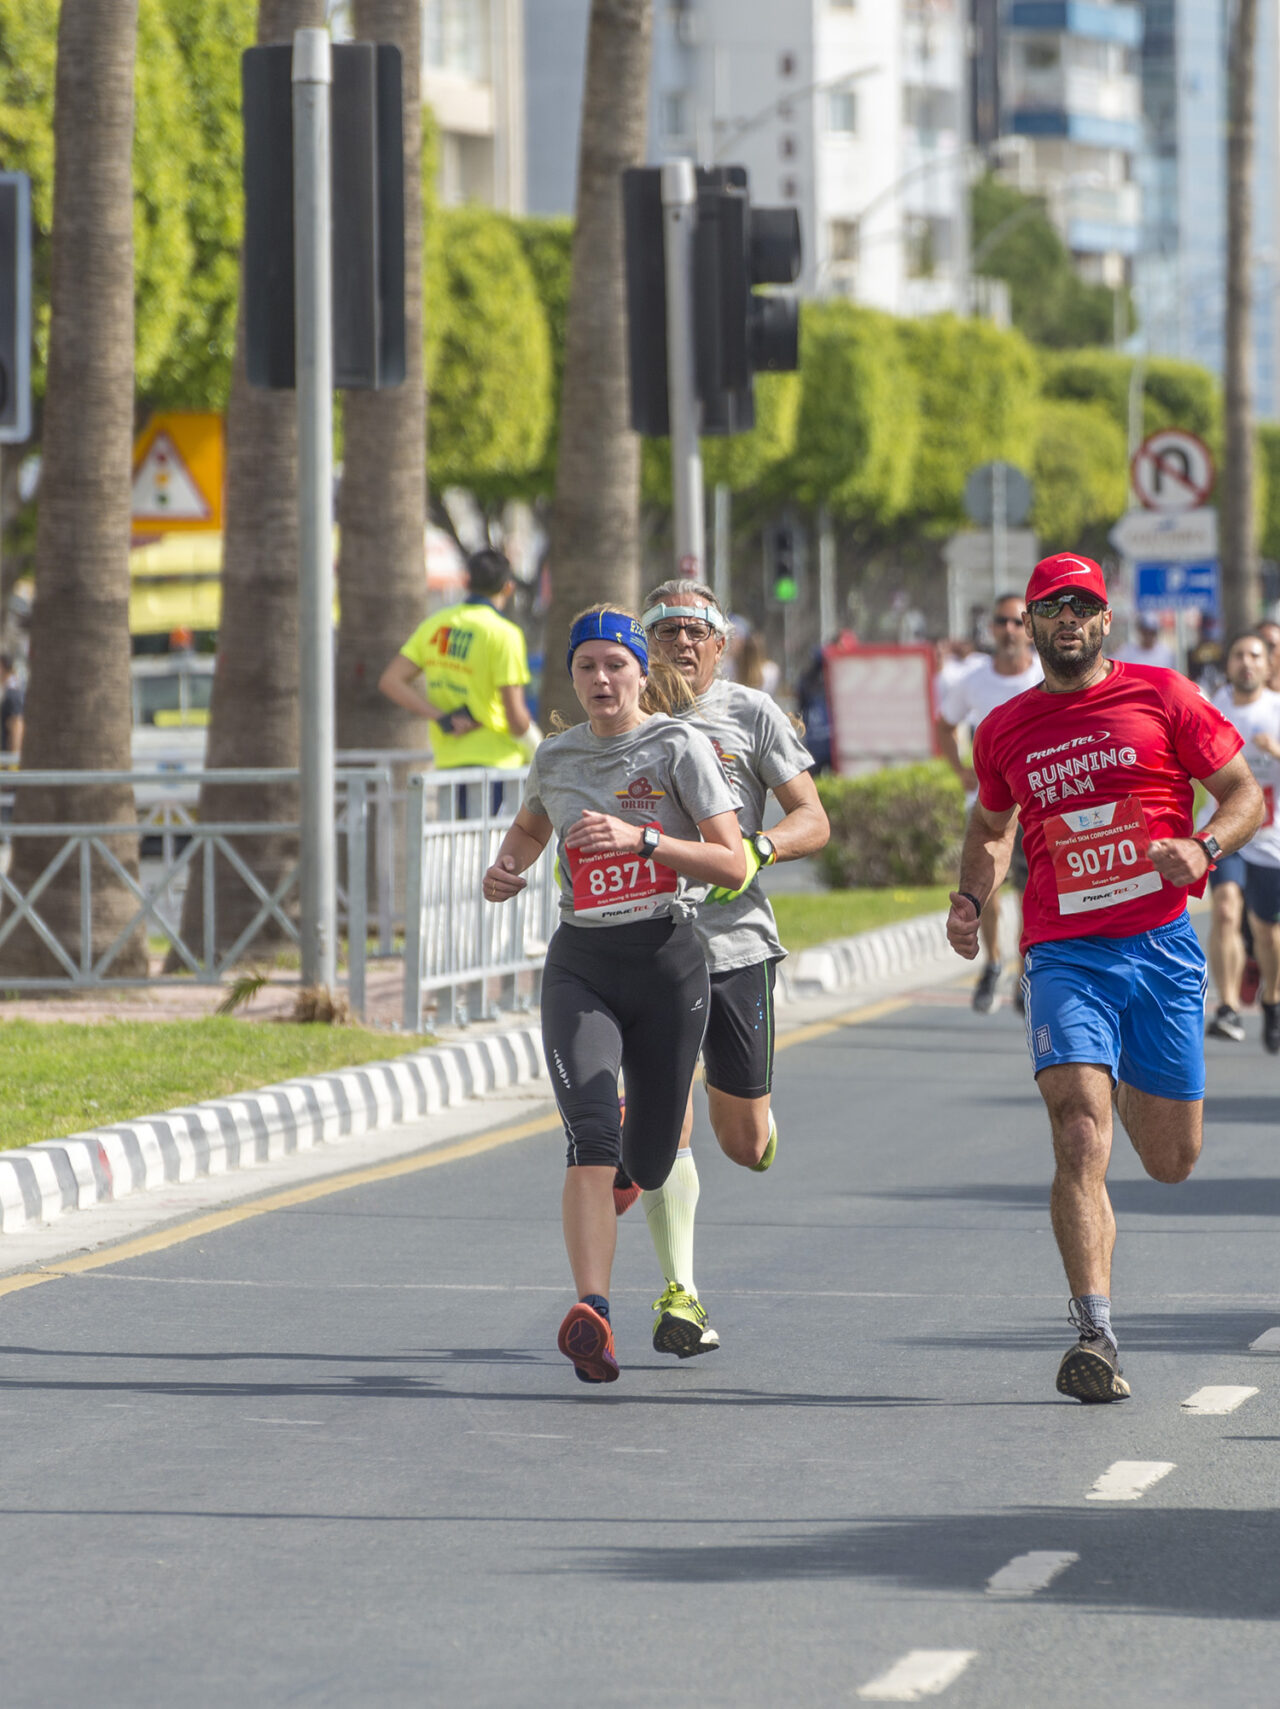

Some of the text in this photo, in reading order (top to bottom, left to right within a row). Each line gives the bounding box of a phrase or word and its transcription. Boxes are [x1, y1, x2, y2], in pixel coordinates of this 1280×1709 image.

[1027, 747, 1137, 791] RUNNING
[621, 800, 657, 810] ORBIT
[1034, 774, 1096, 809] TEAM
[1056, 837, 1077, 847] PrimeTel
[1090, 827, 1124, 840] CORPORATE
[1123, 821, 1140, 831] RACE
[1066, 839, 1138, 877] 9070
[589, 858, 657, 896] 8371
